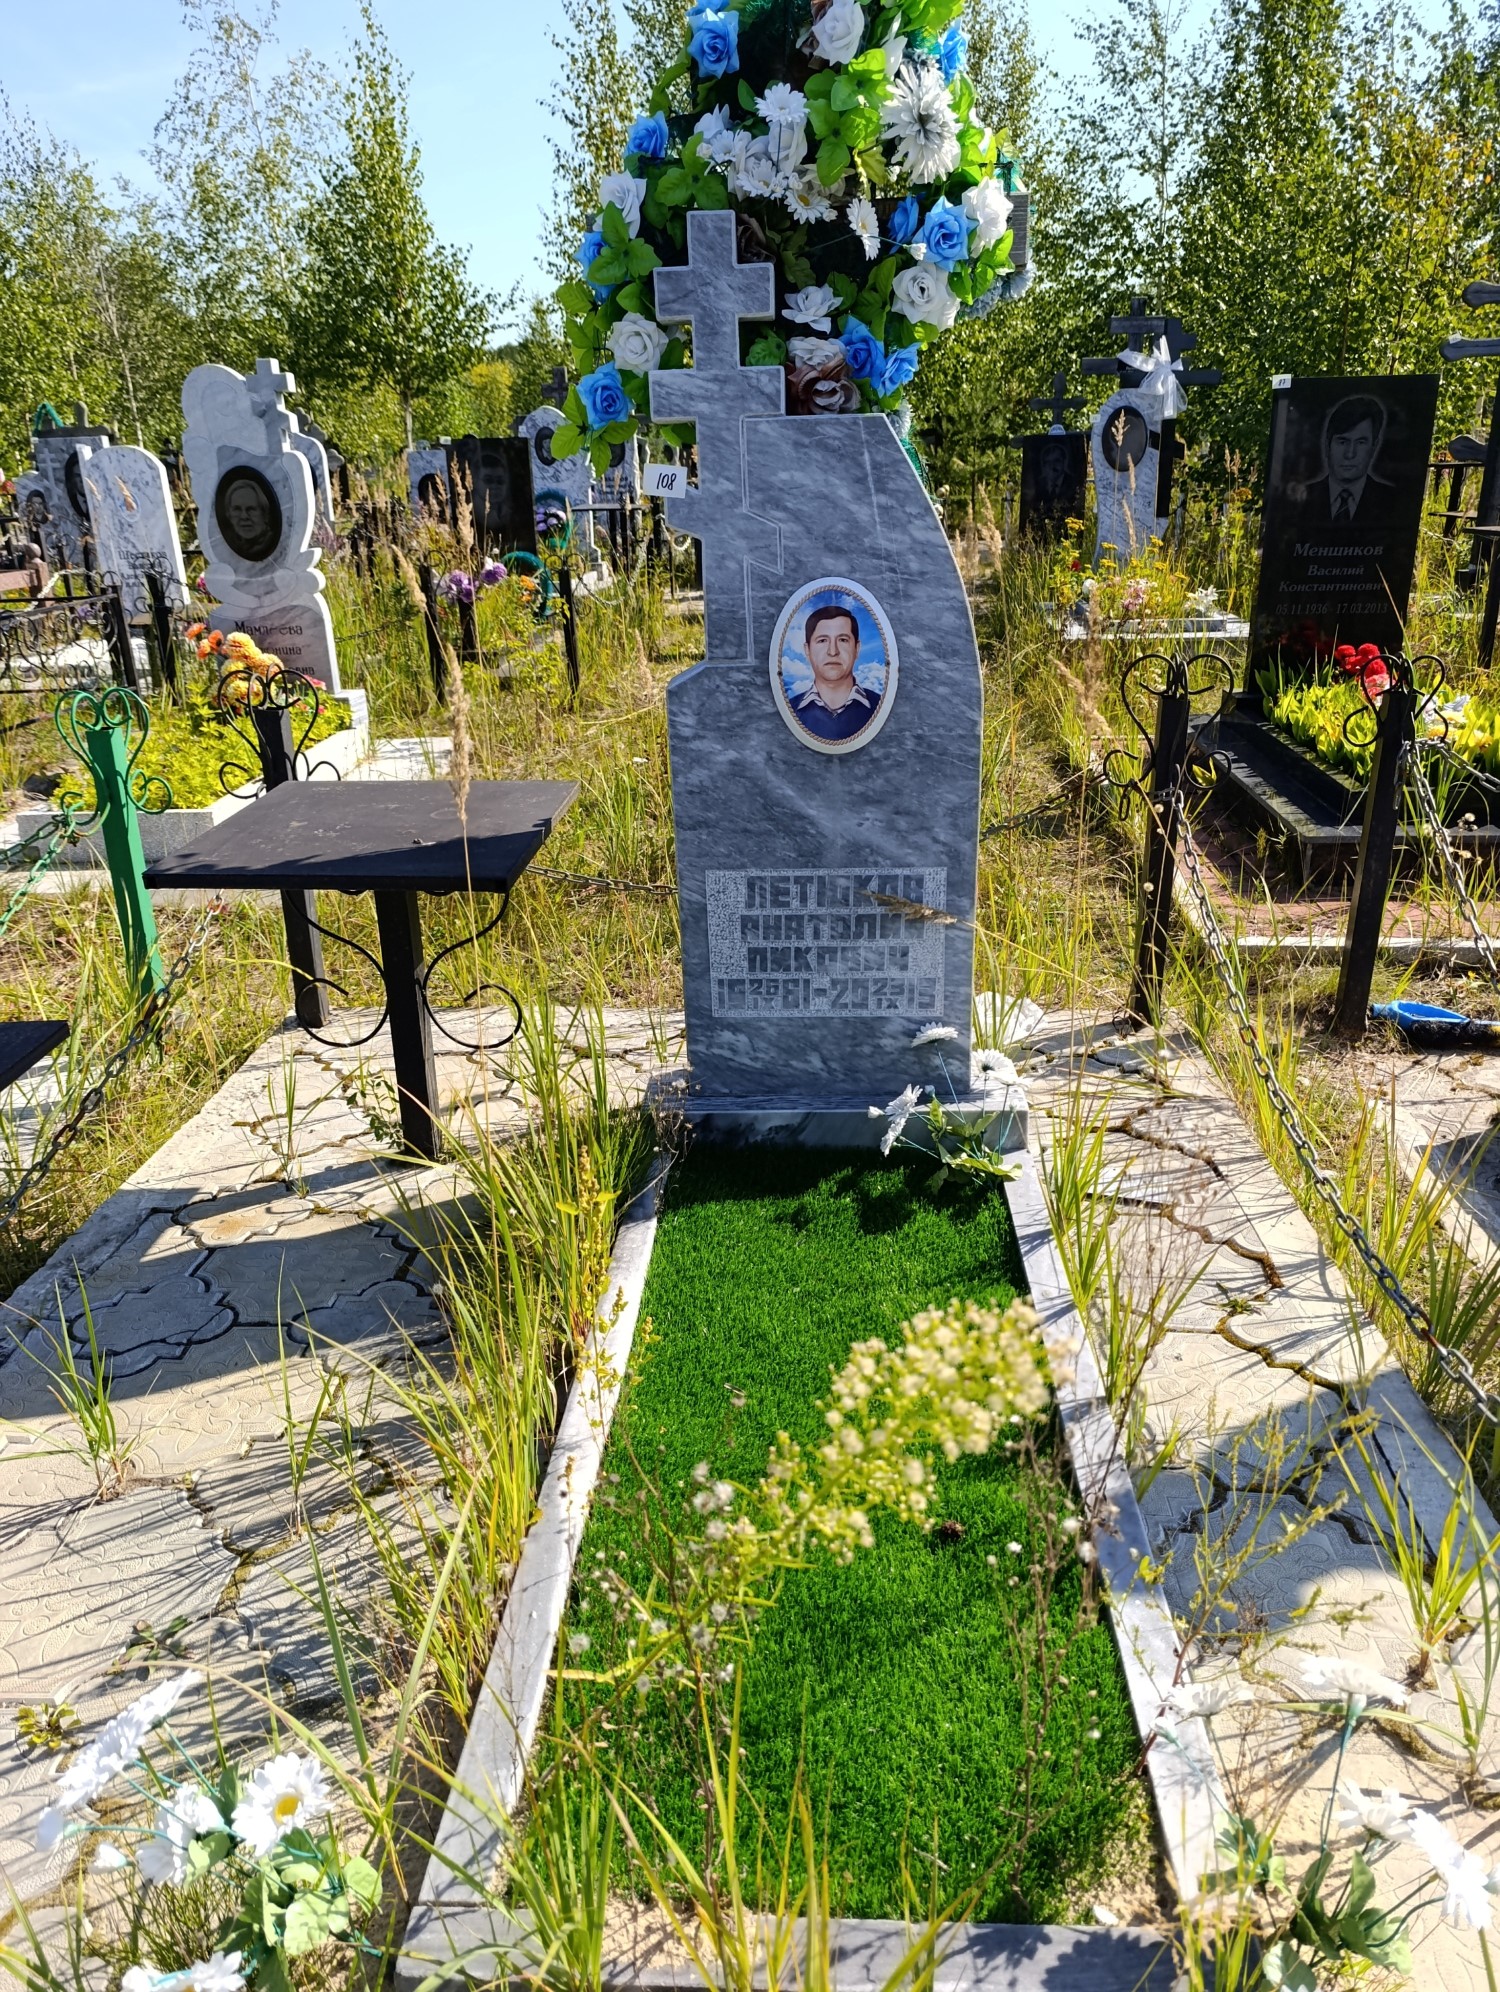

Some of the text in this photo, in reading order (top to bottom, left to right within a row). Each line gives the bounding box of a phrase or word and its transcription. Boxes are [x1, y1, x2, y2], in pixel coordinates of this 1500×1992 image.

[656, 472, 677, 491] 108
[1307, 564, 1365, 577] Василий
[1336, 602, 1389, 615] 17.03.2013
